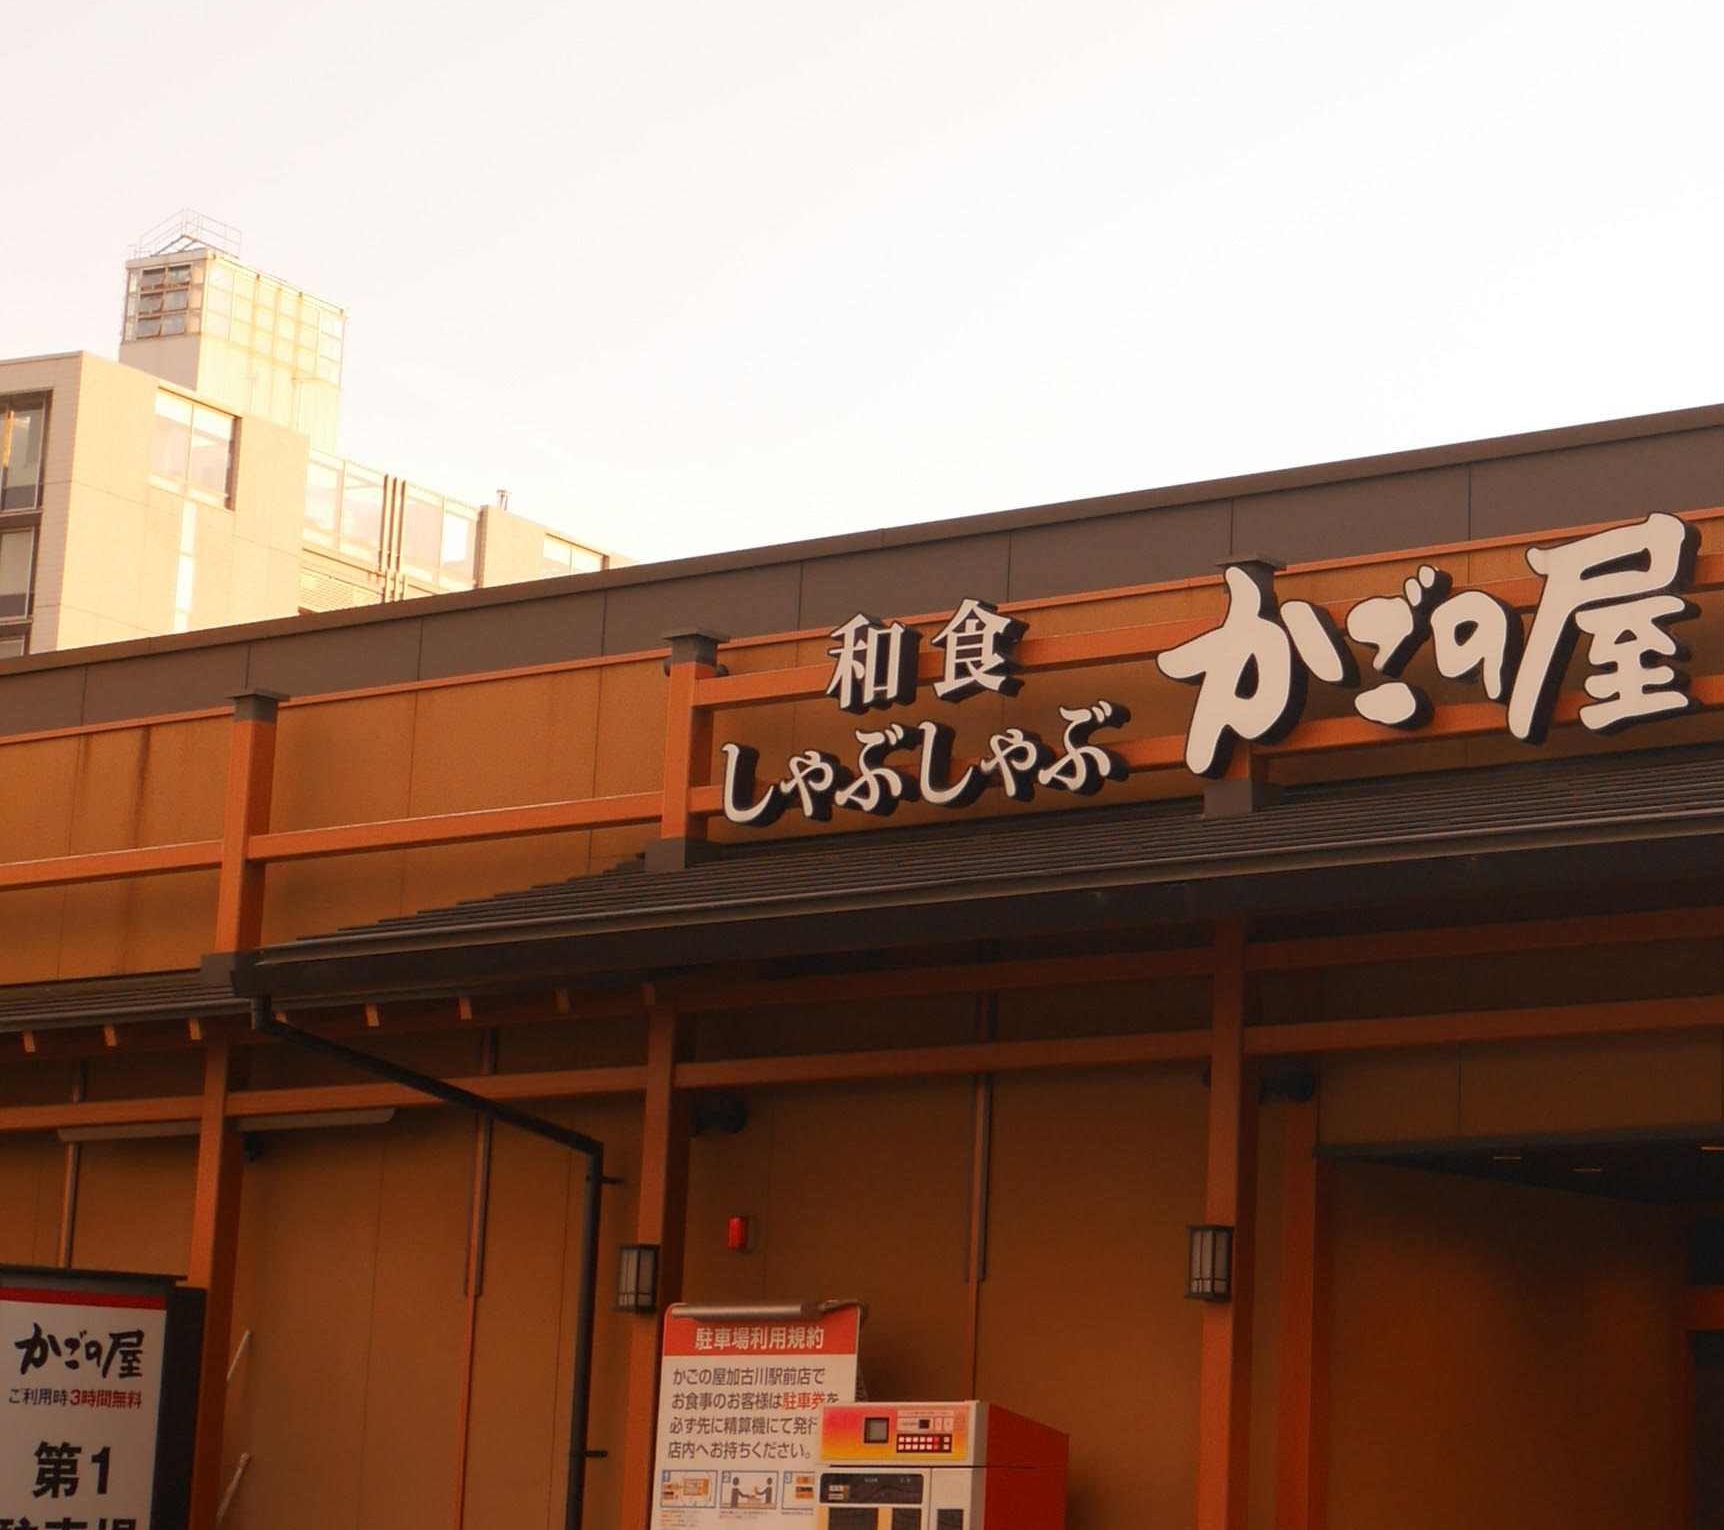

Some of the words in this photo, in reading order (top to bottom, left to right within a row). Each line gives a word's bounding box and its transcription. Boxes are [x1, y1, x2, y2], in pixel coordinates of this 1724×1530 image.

[827, 596, 1018, 712] 和食
[1157, 512, 1696, 777] かごの屋
[721, 699, 1120, 826] しゃぶしゃぶ
[15, 1323, 146, 1379] かごの屋
[695, 1326, 825, 1351] 駐車場利用規約
[672, 1367, 826, 1386] かごの屋加古川駅前店で
[8, 1387, 143, 1410] ご利用時3時間無料
[668, 1441, 811, 1460] 店内へお持ちください。
